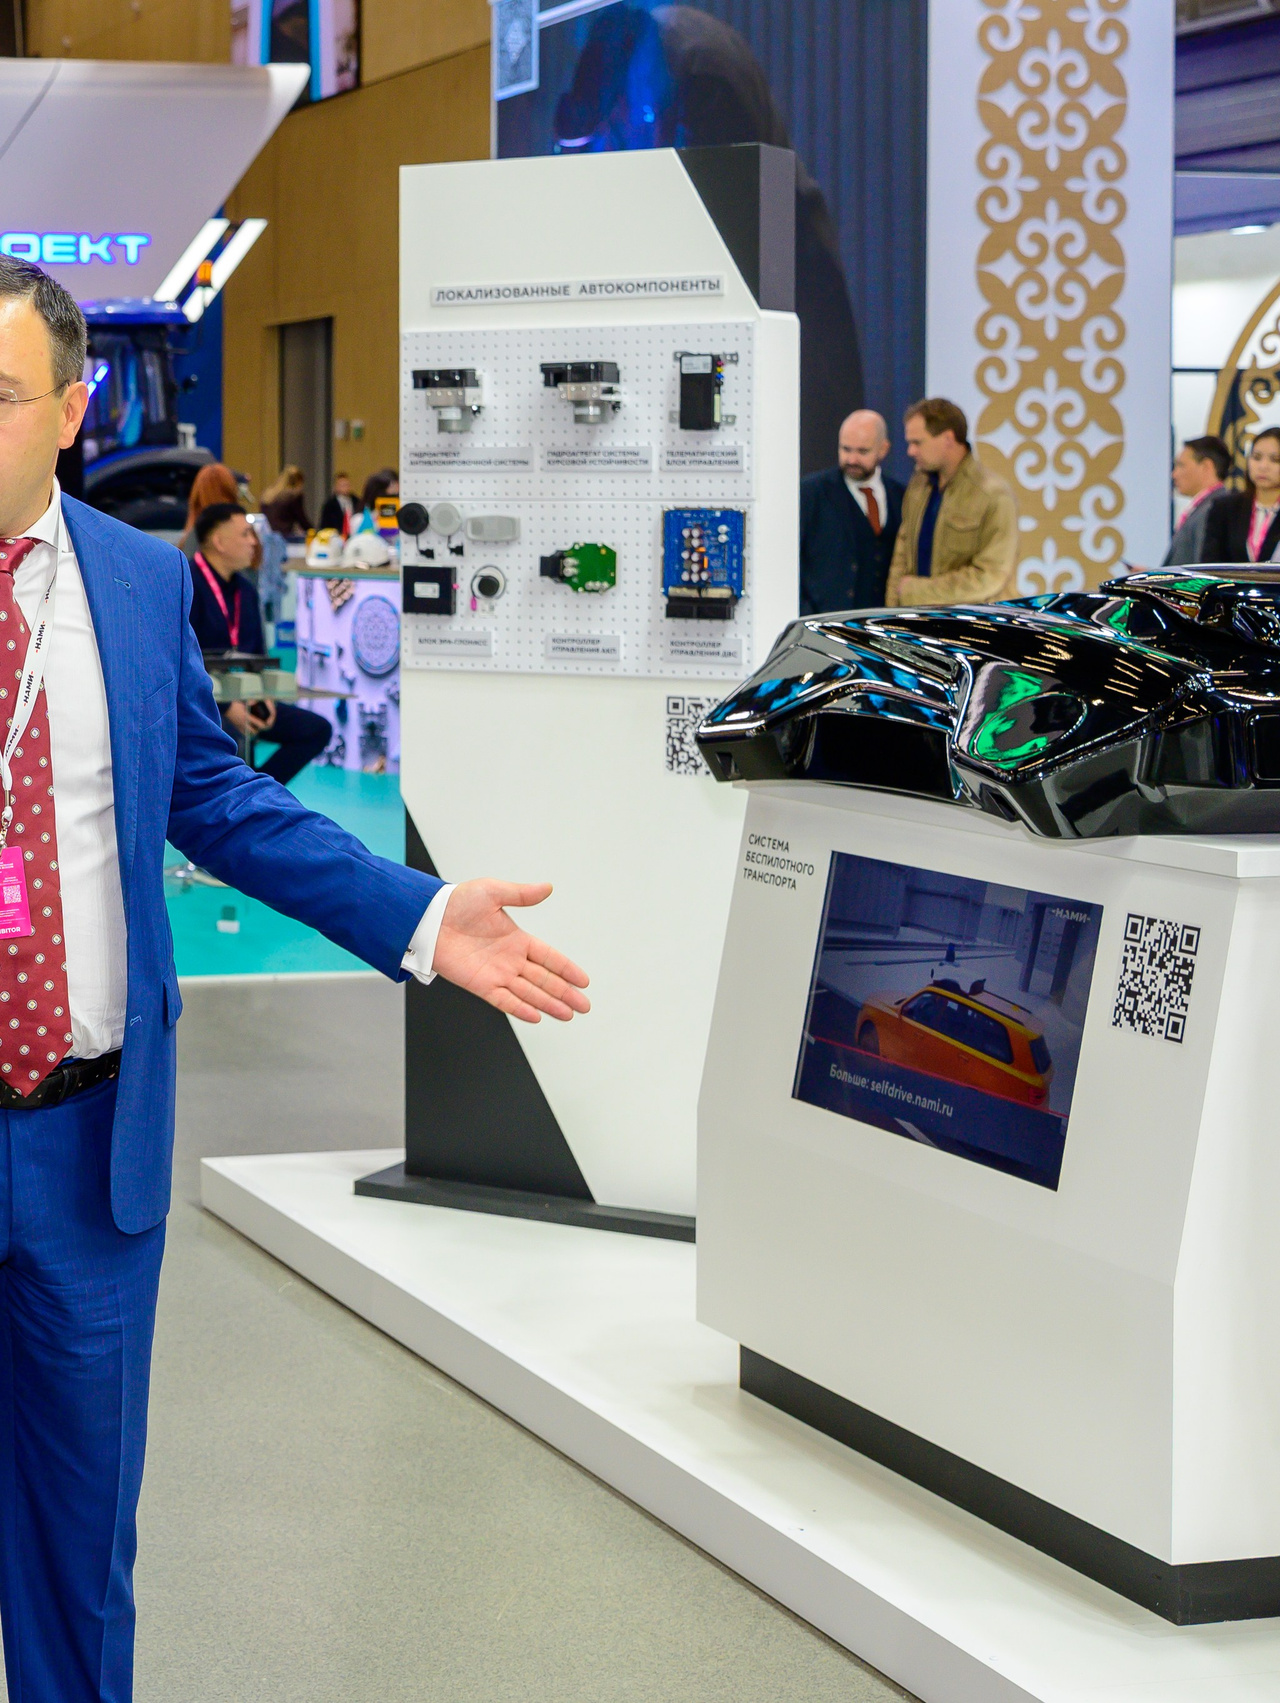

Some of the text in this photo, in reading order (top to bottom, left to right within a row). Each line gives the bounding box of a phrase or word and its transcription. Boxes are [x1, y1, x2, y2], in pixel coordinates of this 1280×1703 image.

[435, 279, 721, 302] ЛОКАЛИЗОВАННЫЕ АВТОКОМПОНЕНТЫ
[670, 640, 721, 648] КОНТРОЛЛЕР
[748, 833, 790, 853] СИСТЕМА
[745, 850, 815, 876] БЕСПИЛОТНОГО
[743, 867, 797, 890] ТРАНСПОРТА
[829, 1063, 954, 1118] Больше: selfdrive.nami.ru
